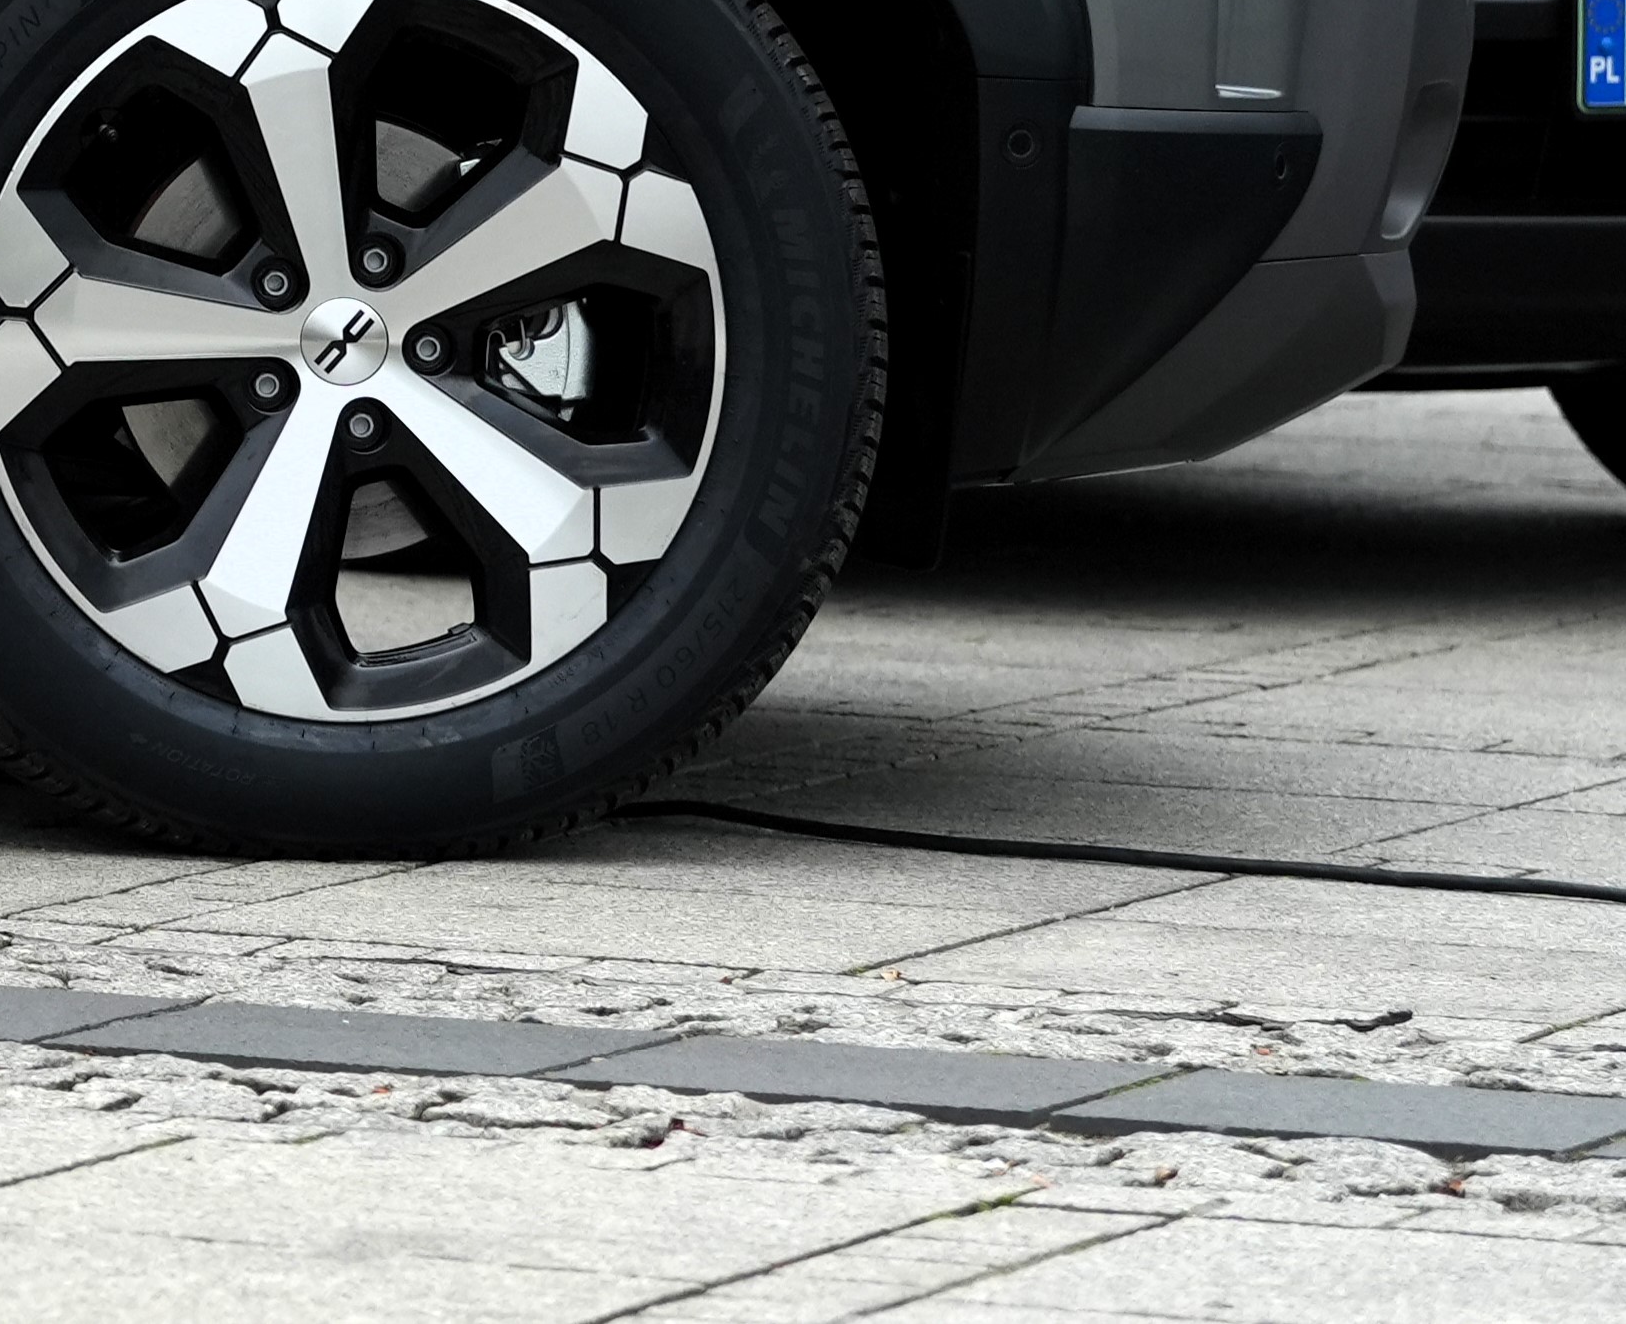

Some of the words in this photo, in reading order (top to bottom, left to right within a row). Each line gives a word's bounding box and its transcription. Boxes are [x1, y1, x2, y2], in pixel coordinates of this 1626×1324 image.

[1589, 55, 1620, 84] PL
[757, 208, 825, 539] MICHELIN
[580, 707, 619, 747] 18
